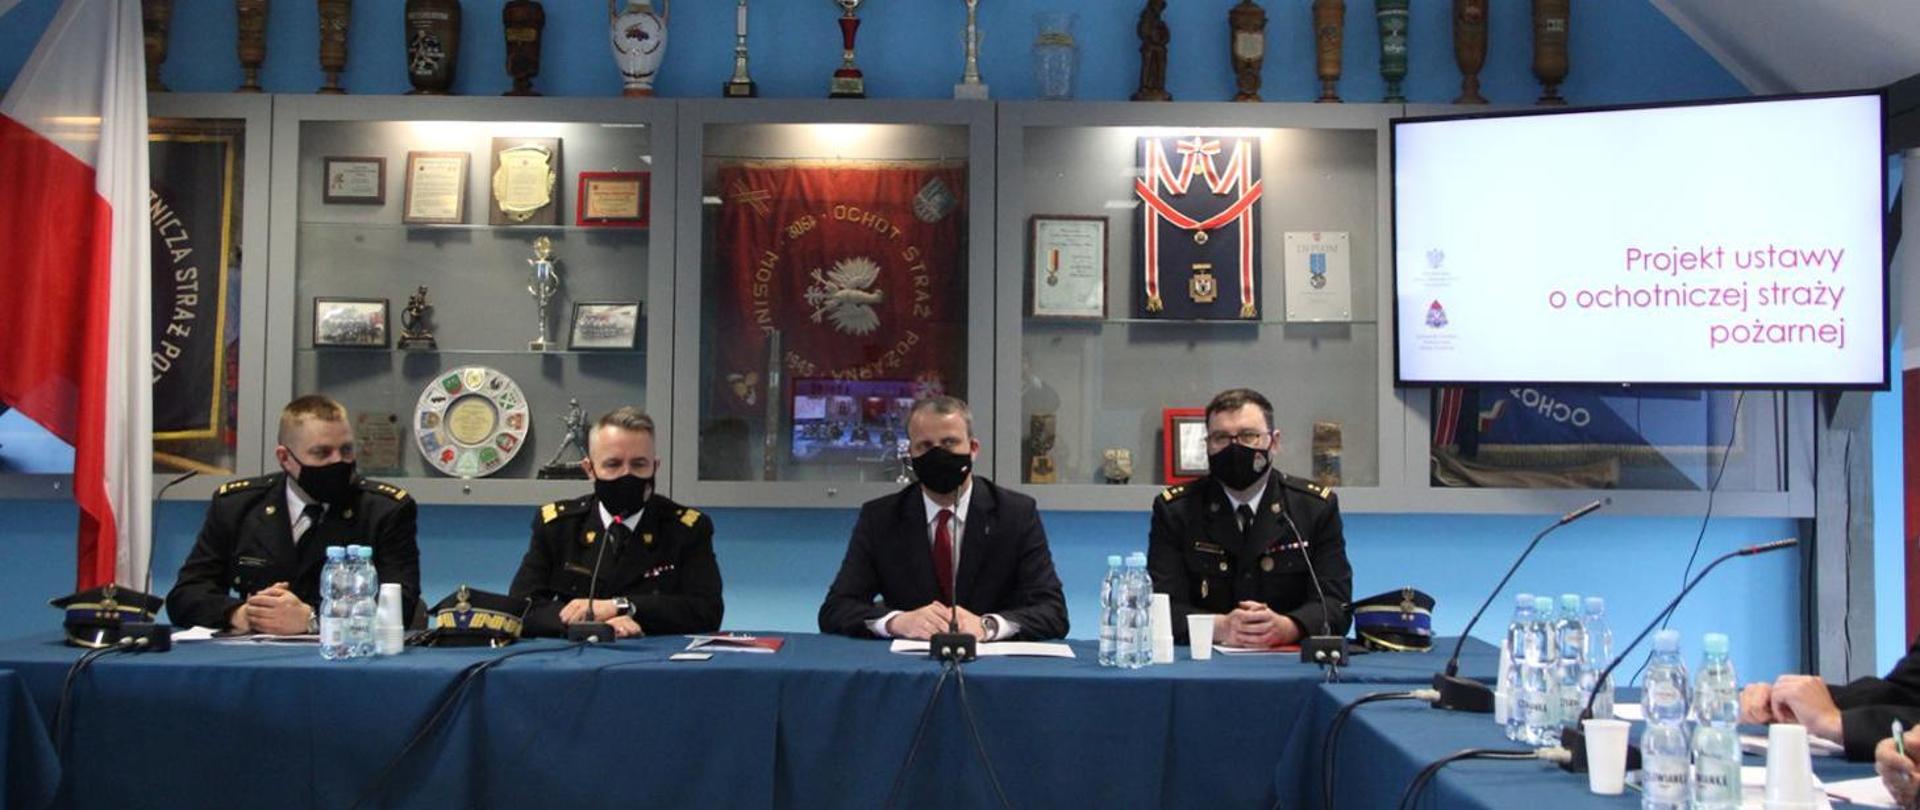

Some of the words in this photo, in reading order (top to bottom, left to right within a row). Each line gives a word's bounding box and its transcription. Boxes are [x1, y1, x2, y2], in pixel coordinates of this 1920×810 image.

[833, 204, 903, 242] OCHOT
[1626, 246, 1724, 277] Projekt
[1735, 244, 1845, 273] ustawy
[1549, 290, 1567, 308] o
[1576, 281, 1748, 312] ochotniczej
[1758, 280, 1845, 311] straży
[1711, 317, 1845, 349] pożarnej
[151, 340, 181, 384] PO
